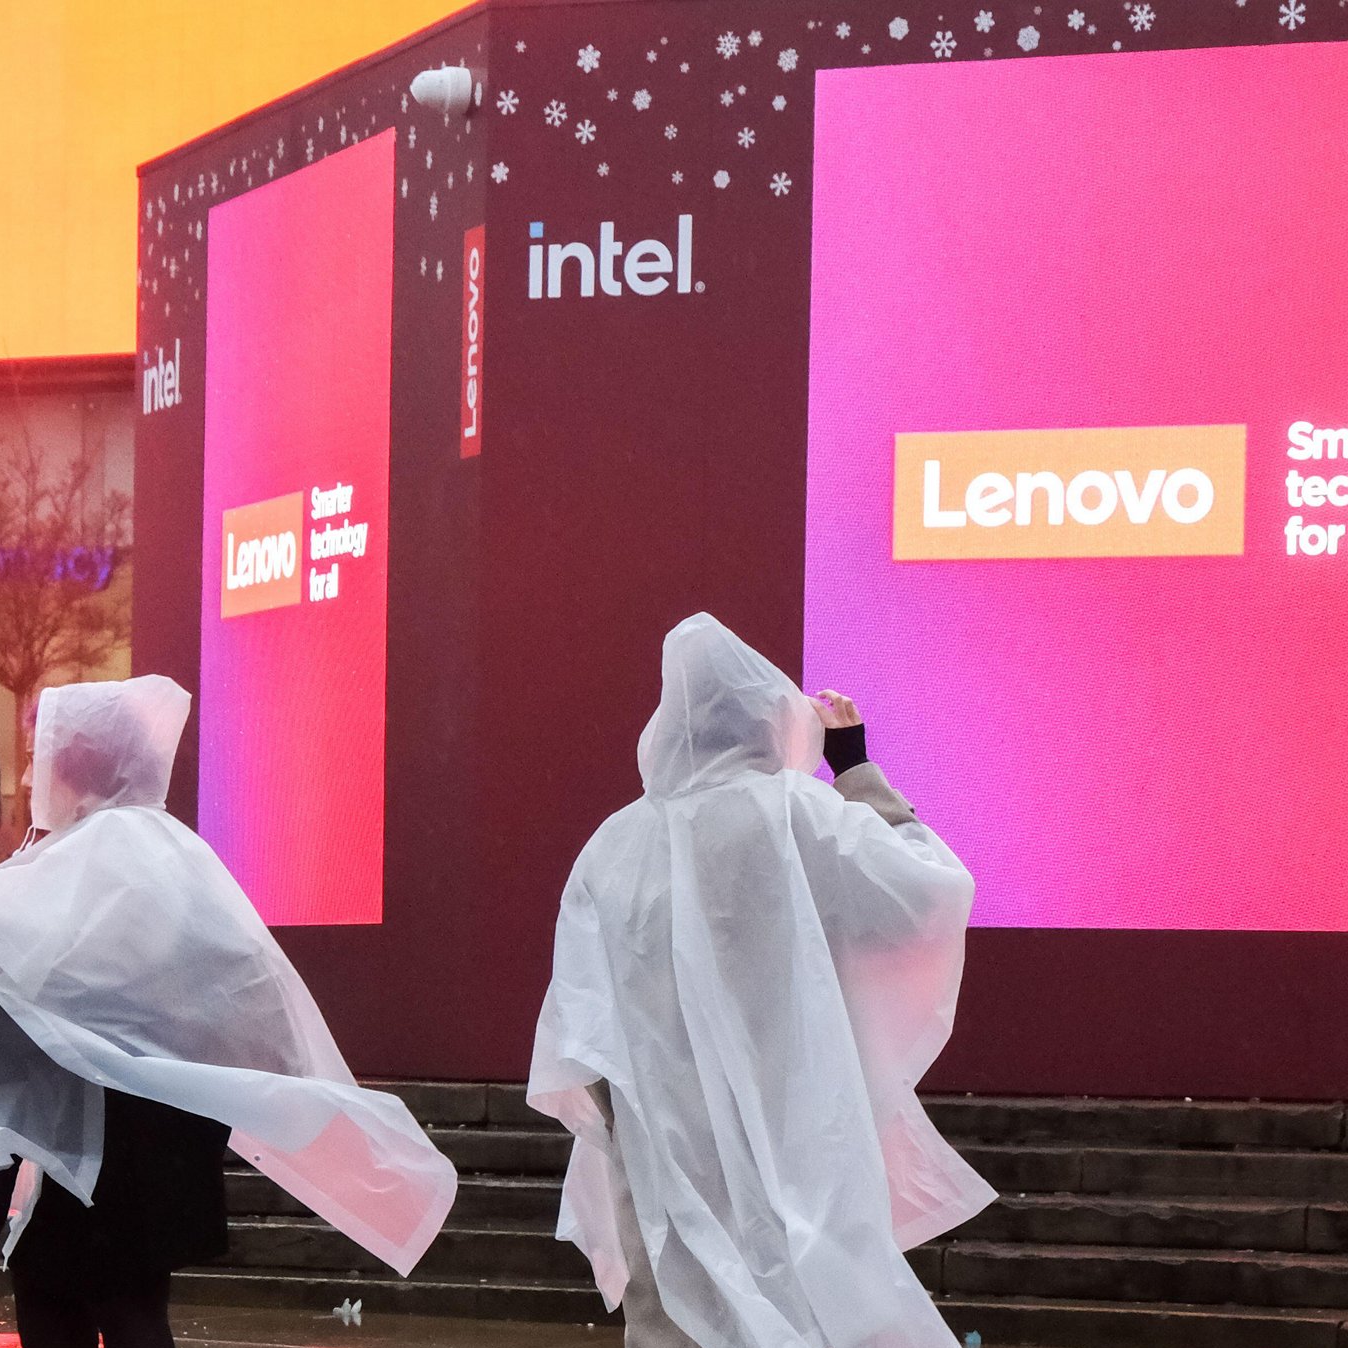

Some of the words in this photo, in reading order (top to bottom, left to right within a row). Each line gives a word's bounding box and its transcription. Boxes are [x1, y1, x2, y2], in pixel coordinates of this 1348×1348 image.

[528, 214, 693, 299] intel
[464, 247, 480, 438] Lenovo
[142, 338, 181, 415] intel
[310, 482, 353, 520] Smarter
[922, 459, 1214, 528] Lenovo
[226, 531, 297, 590] Lenovo
[309, 518, 368, 560] technology
[1284, 515, 1346, 556] for
[309, 567, 325, 602] for
[325, 563, 339, 599] all
